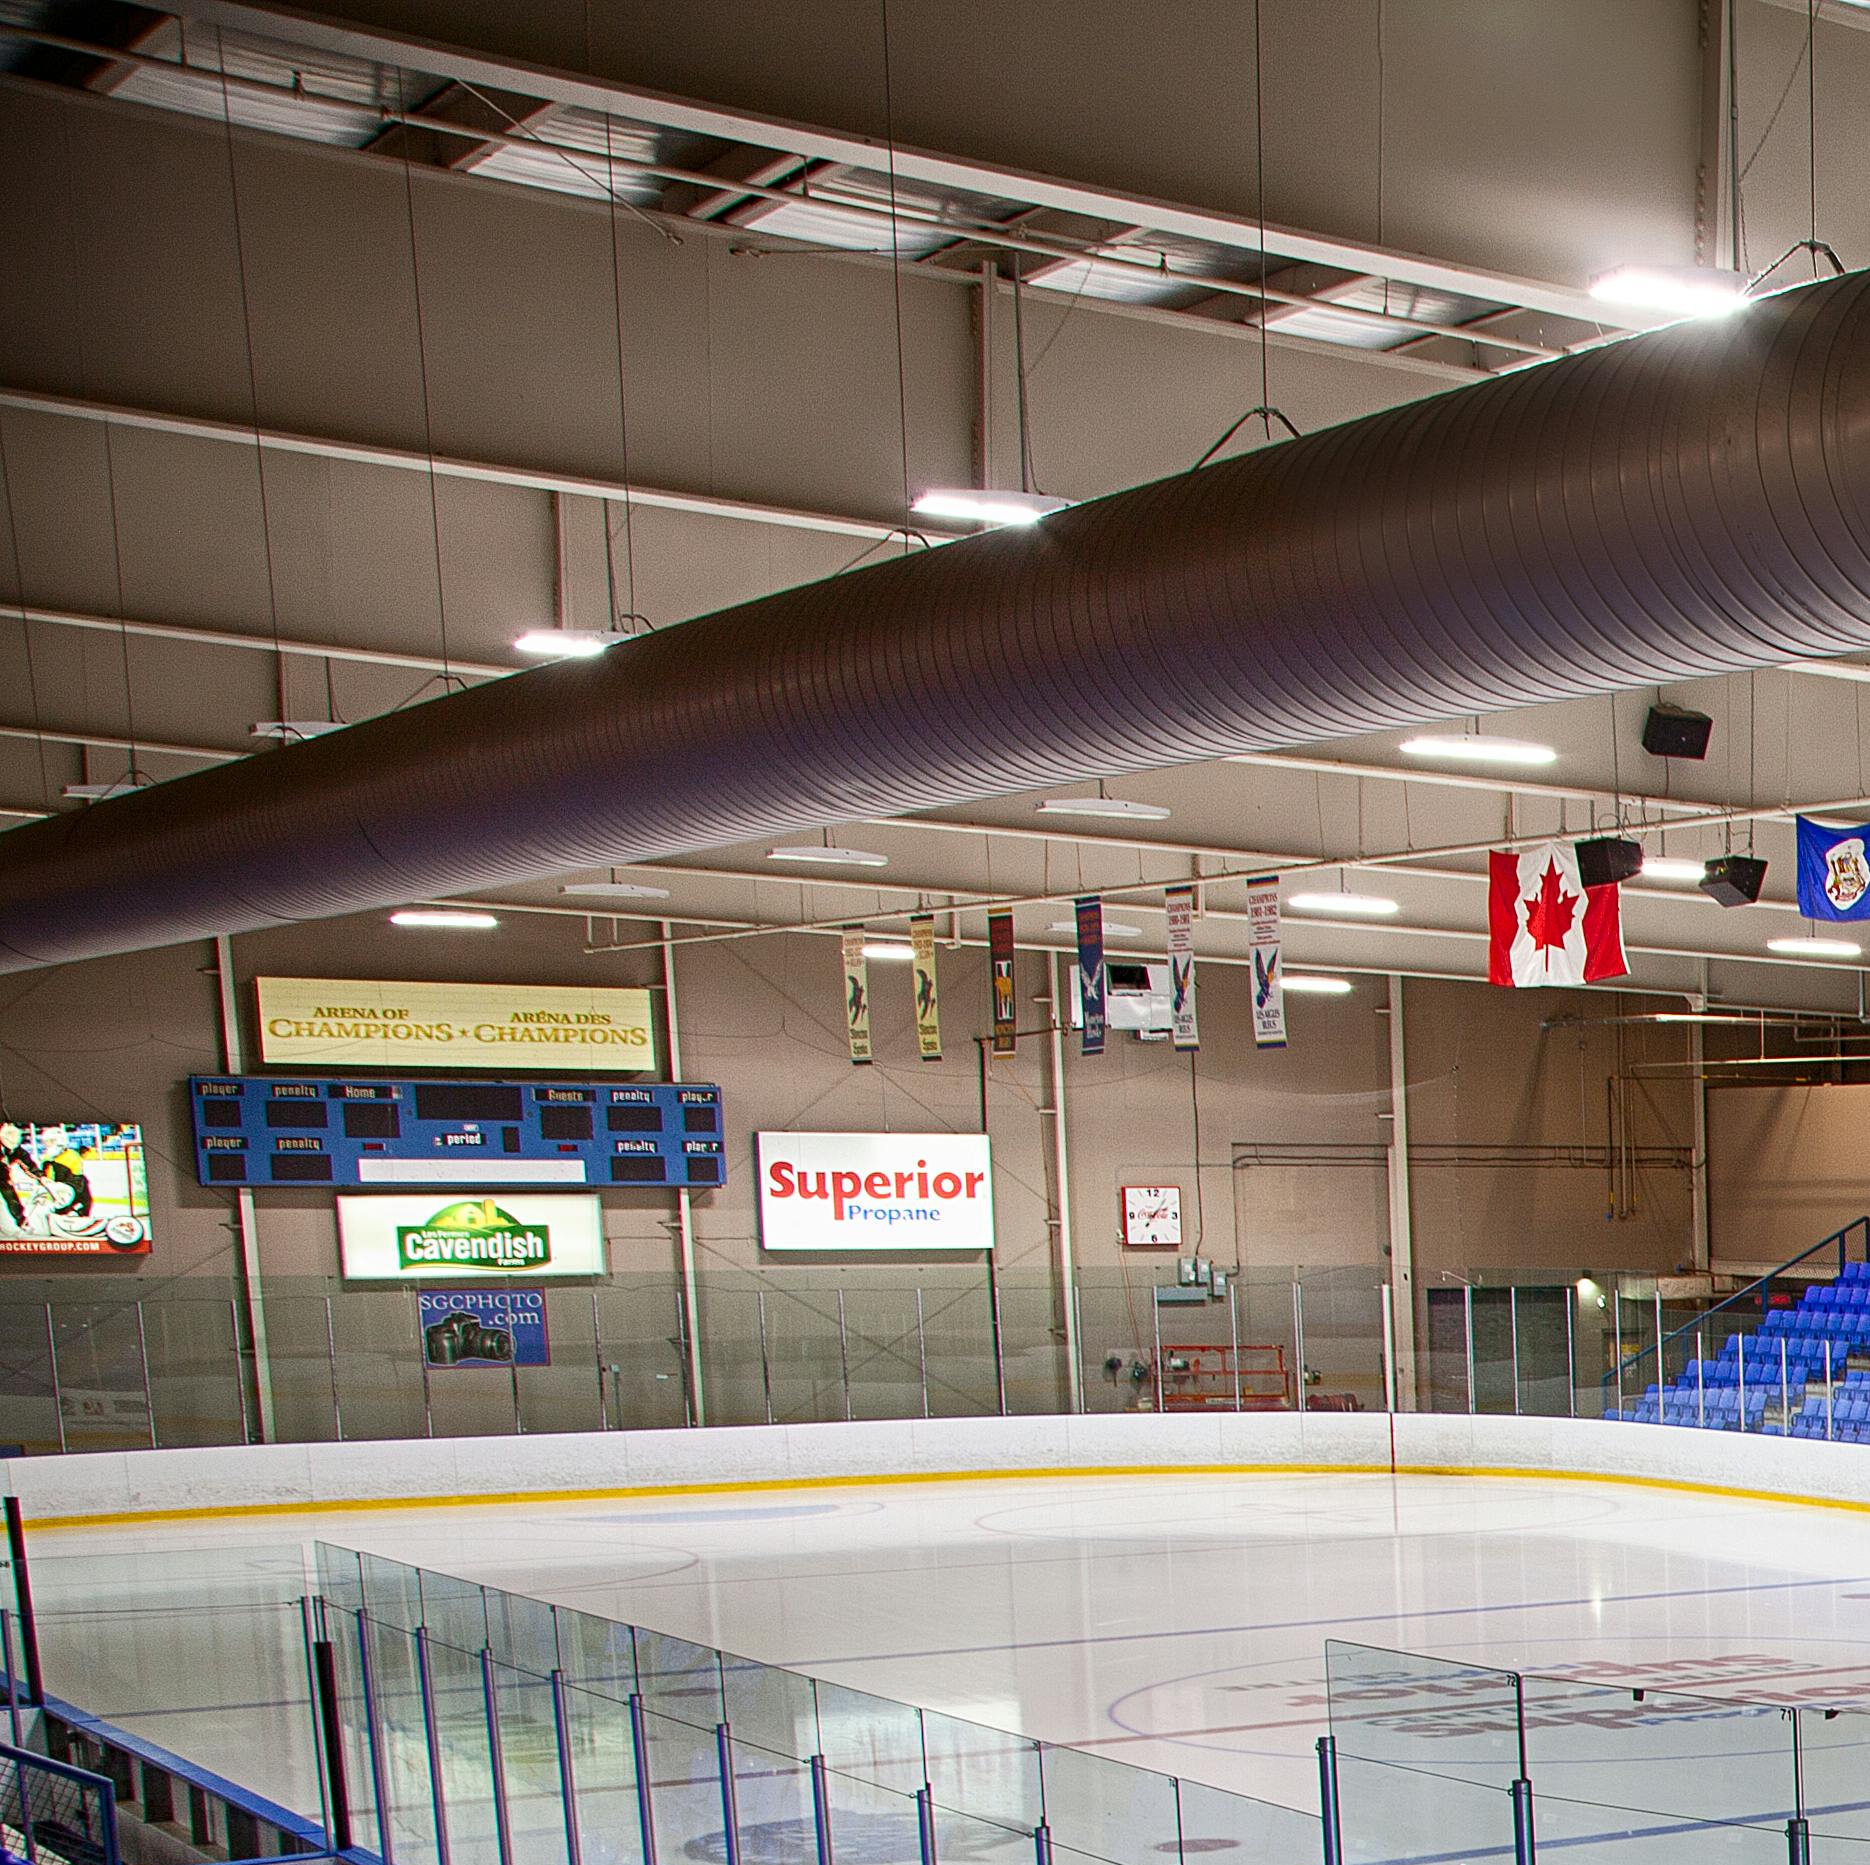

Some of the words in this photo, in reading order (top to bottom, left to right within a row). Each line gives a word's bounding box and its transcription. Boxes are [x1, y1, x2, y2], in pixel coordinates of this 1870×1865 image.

[313, 1006, 376, 1020] ARENA
[382, 1007, 409, 1020] OF
[510, 1009, 570, 1024] ARÉNA
[575, 1012, 612, 1025] DES
[268, 1018, 454, 1042] CHAMPIONS
[474, 1023, 648, 1047] CHAMPIONS
[201, 1083, 238, 1096] player
[273, 1085, 317, 1098] penalty
[345, 1086, 376, 1099] Home
[612, 1090, 651, 1104] penalty
[205, 1137, 243, 1150] player
[278, 1139, 320, 1151] penalty
[446, 1133, 482, 1146] period
[768, 1159, 984, 1221] Superior
[1146, 1188, 1160, 1198] 12
[848, 1204, 941, 1225] Propane
[1171, 1211, 1178, 1220] 3
[404, 1230, 544, 1260] Cavendish
[420, 1293, 543, 1311] SGCPHOTO
[488, 1311, 540, 1325] .com
[1506, 1674, 1517, 1688] 72
[1780, 1708, 1792, 1721] 71
